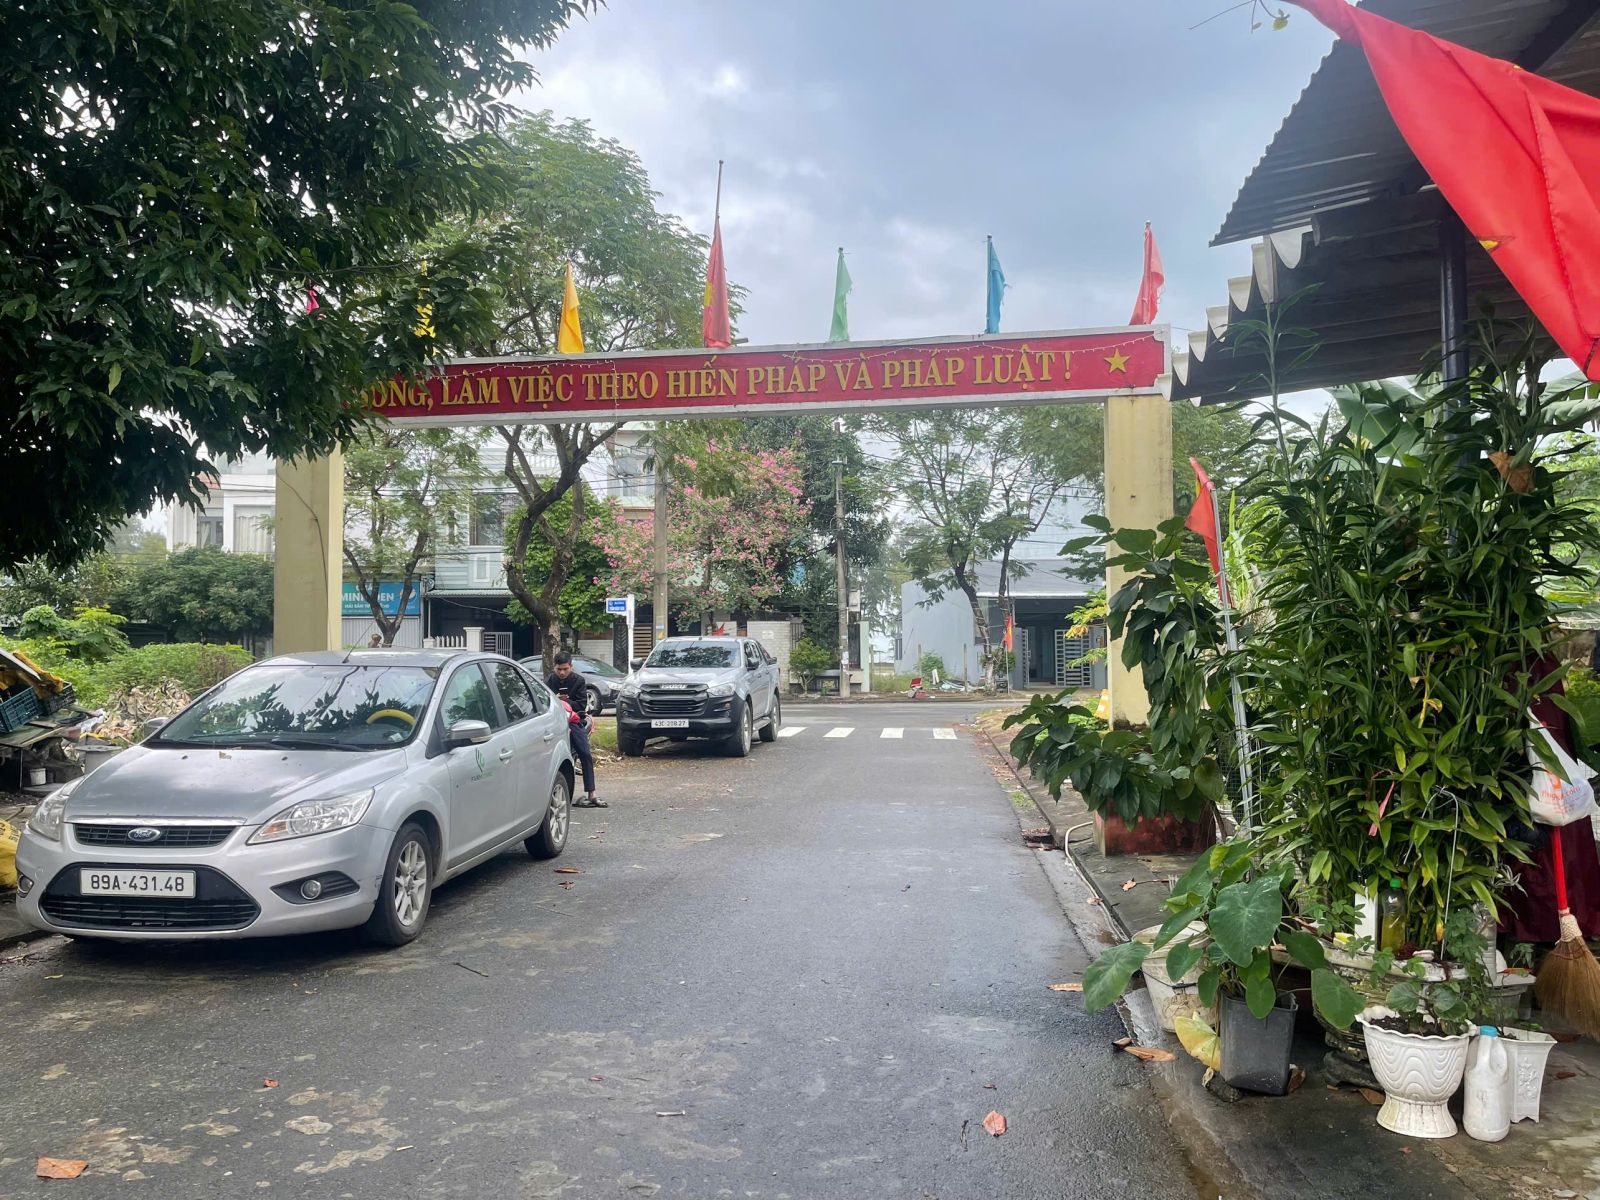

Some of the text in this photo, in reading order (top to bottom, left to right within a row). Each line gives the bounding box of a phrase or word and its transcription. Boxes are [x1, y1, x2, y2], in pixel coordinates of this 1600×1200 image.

[440, 369, 500, 406] LÀM
[507, 367, 575, 410] VIỆC
[581, 371, 660, 402] THEO
[666, 355, 739, 399] HIẾN
[746, 352, 827, 396] PHÁP
[833, 351, 875, 391] VÀ
[882, 349, 966, 390] PHÁP
[972, 344, 1057, 390] LUẬT
[1064, 351, 1072, 381] !
[134, 830, 152, 839] Ford
[90, 874, 185, 892] 89A-431.48
